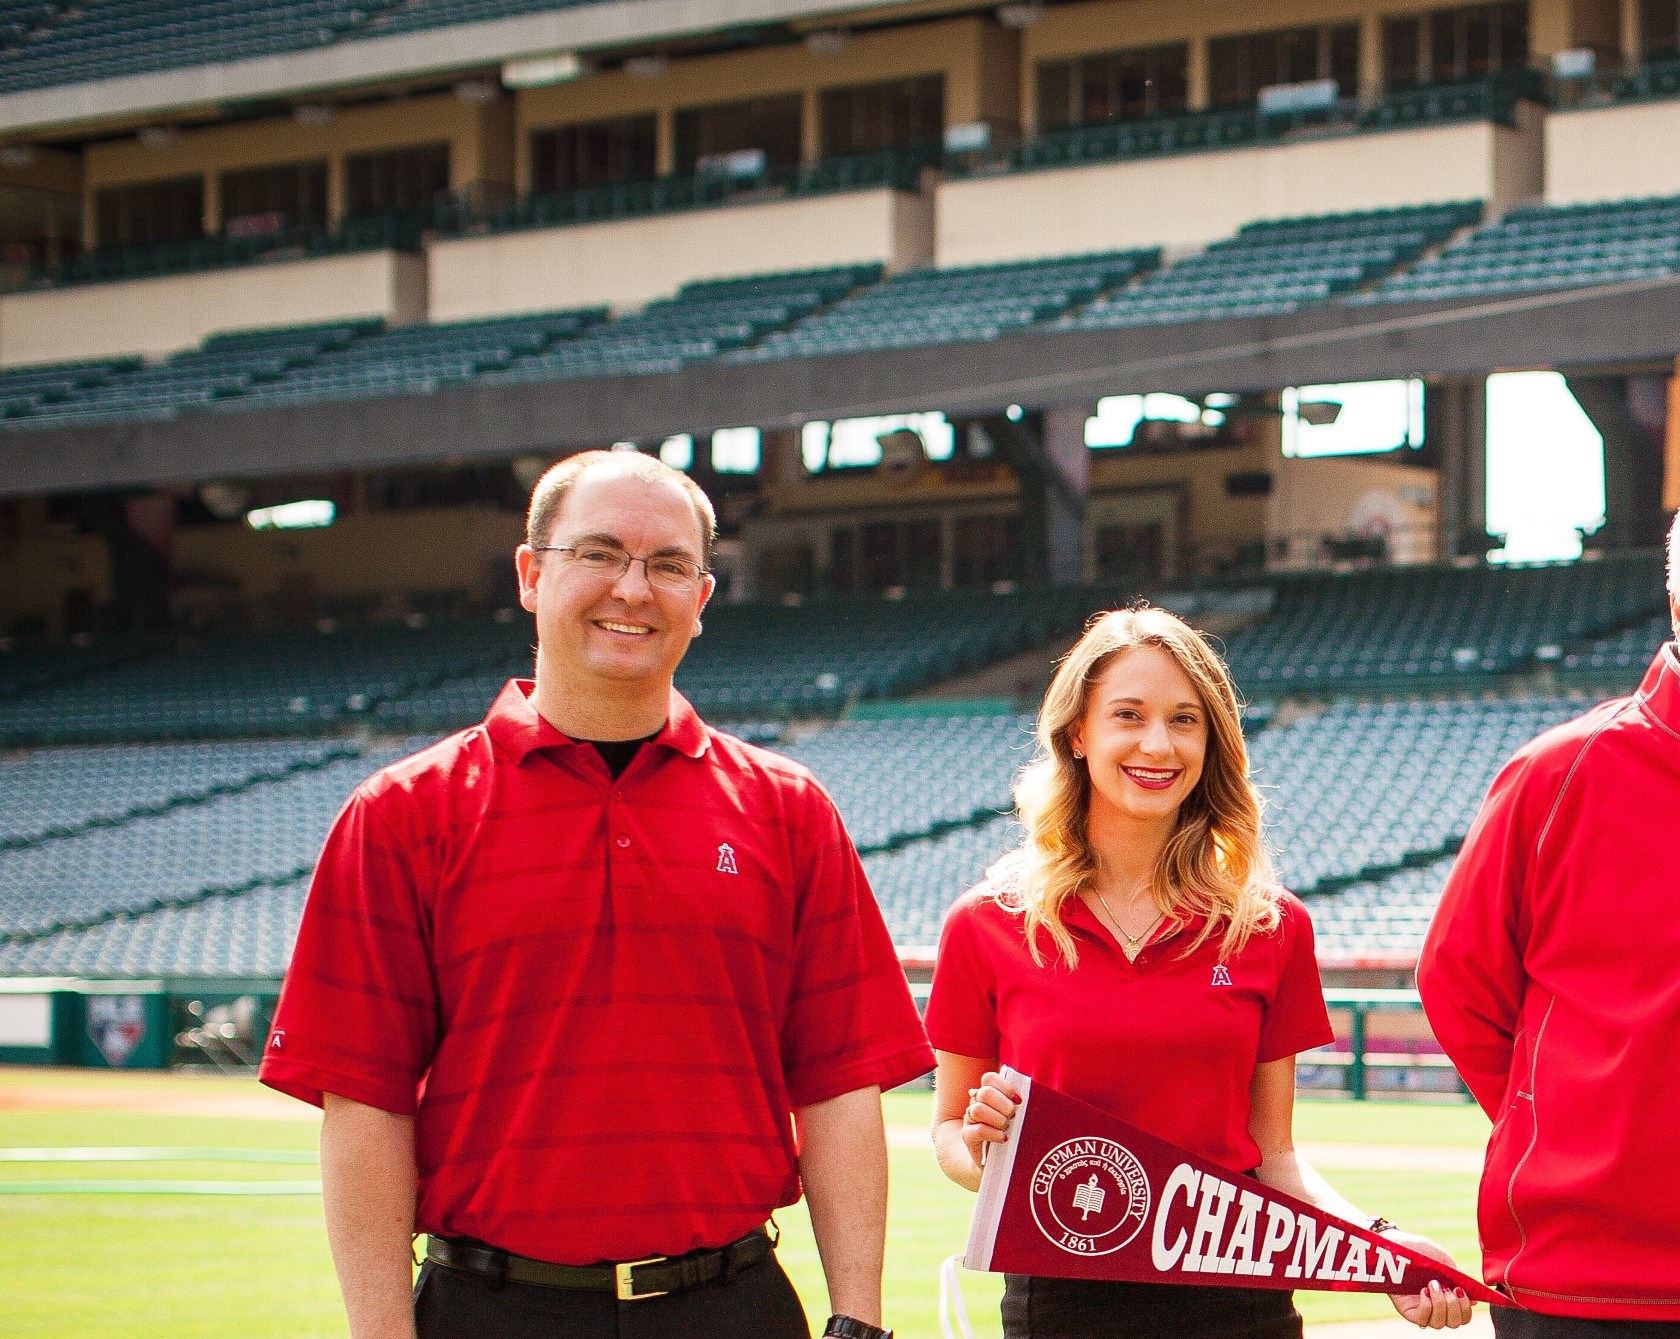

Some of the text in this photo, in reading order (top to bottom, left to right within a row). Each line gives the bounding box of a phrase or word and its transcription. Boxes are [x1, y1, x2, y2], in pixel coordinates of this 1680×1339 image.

[1034, 1141, 1146, 1221] CHAPMAN UNIVERSITY
[1059, 1232, 1096, 1251] 1861
[1151, 1163, 1411, 1284] CHAPMAN
